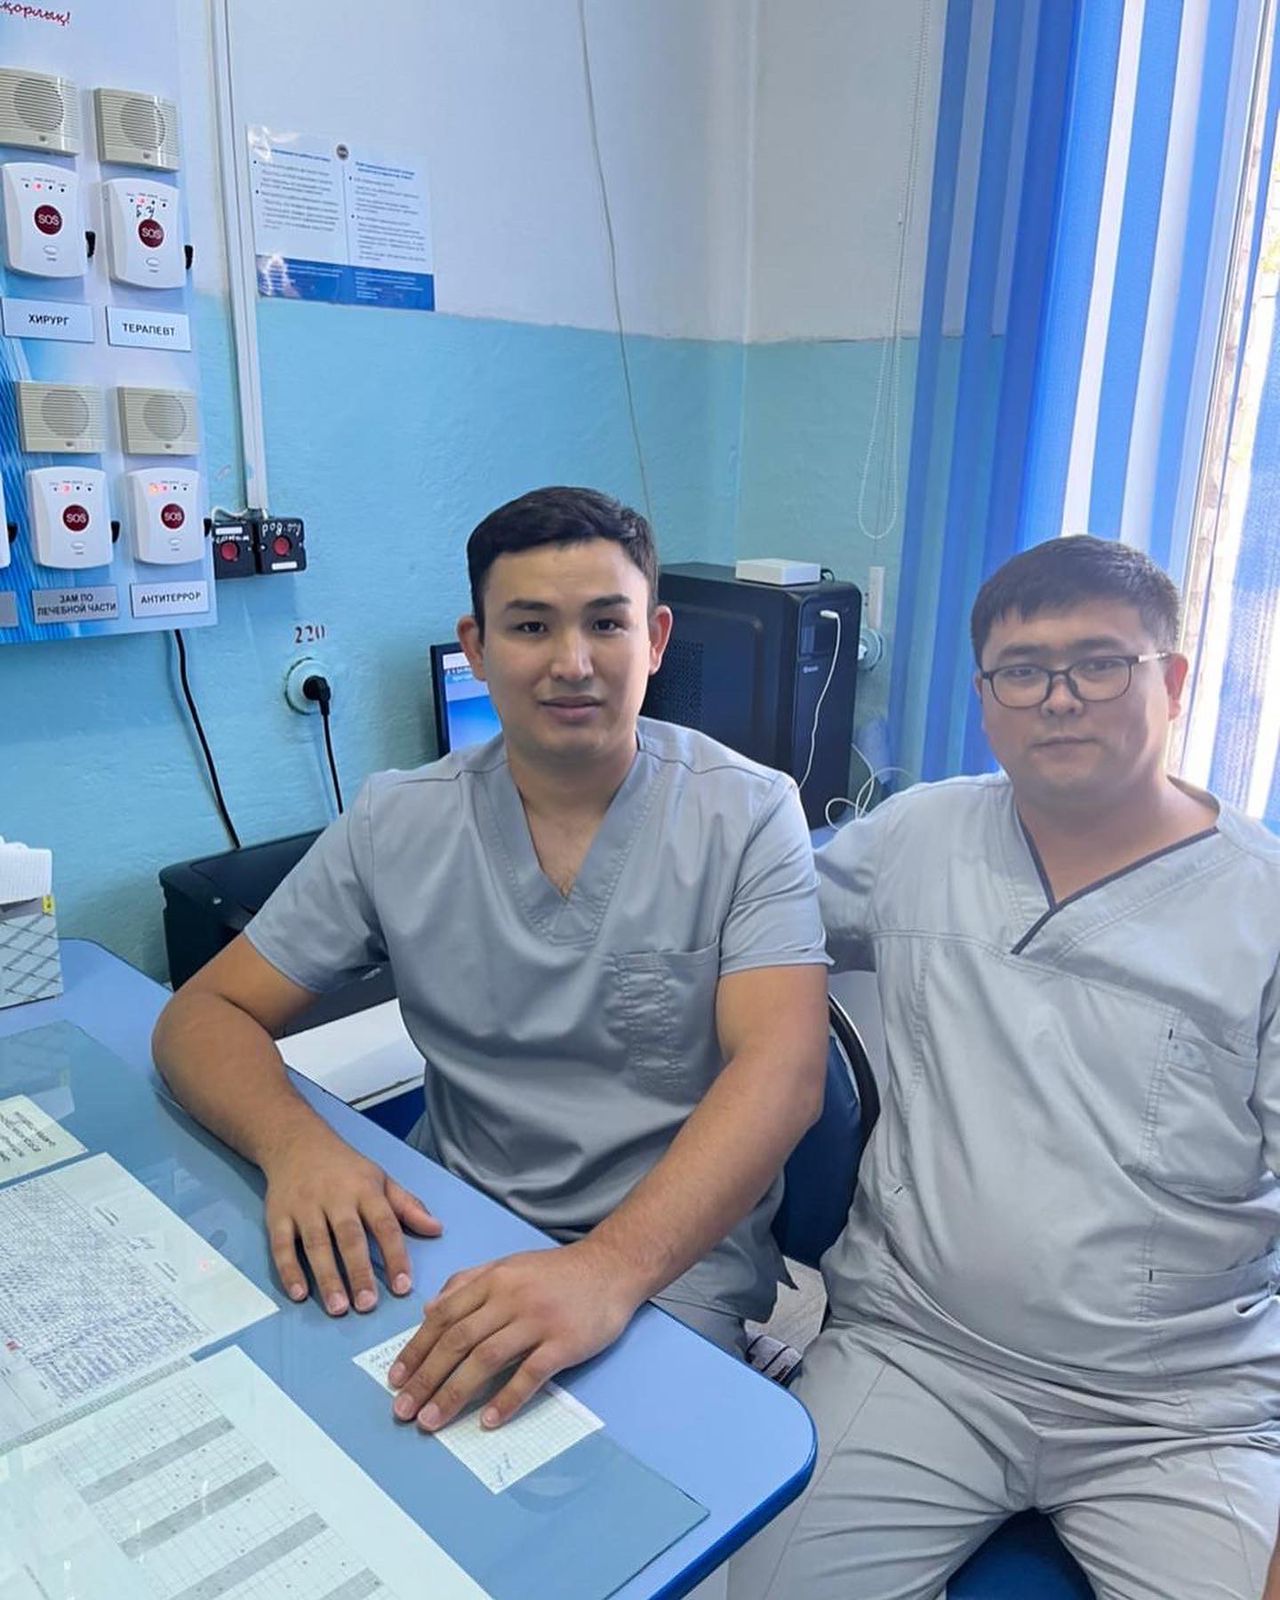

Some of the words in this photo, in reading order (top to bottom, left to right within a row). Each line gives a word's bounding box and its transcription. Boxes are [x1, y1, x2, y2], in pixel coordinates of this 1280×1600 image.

[38, 213, 60, 225] SOS
[141, 227, 162, 239] SOS
[28, 314, 69, 326] ХИРУРГ
[122, 323, 175, 336] ТЕРАПЕВТ
[66, 513, 87, 523] SOS
[163, 511, 183, 521] SOS
[59, 594, 79, 604] ЗАМ
[80, 593, 94, 602] ПО
[141, 592, 201, 604] АНТИТЕРРОР
[37, 604, 86, 616] ЛЕЧЕБНОЙ
[88, 603, 116, 613] ЧАСТИ
[295, 625, 325, 643] 220
